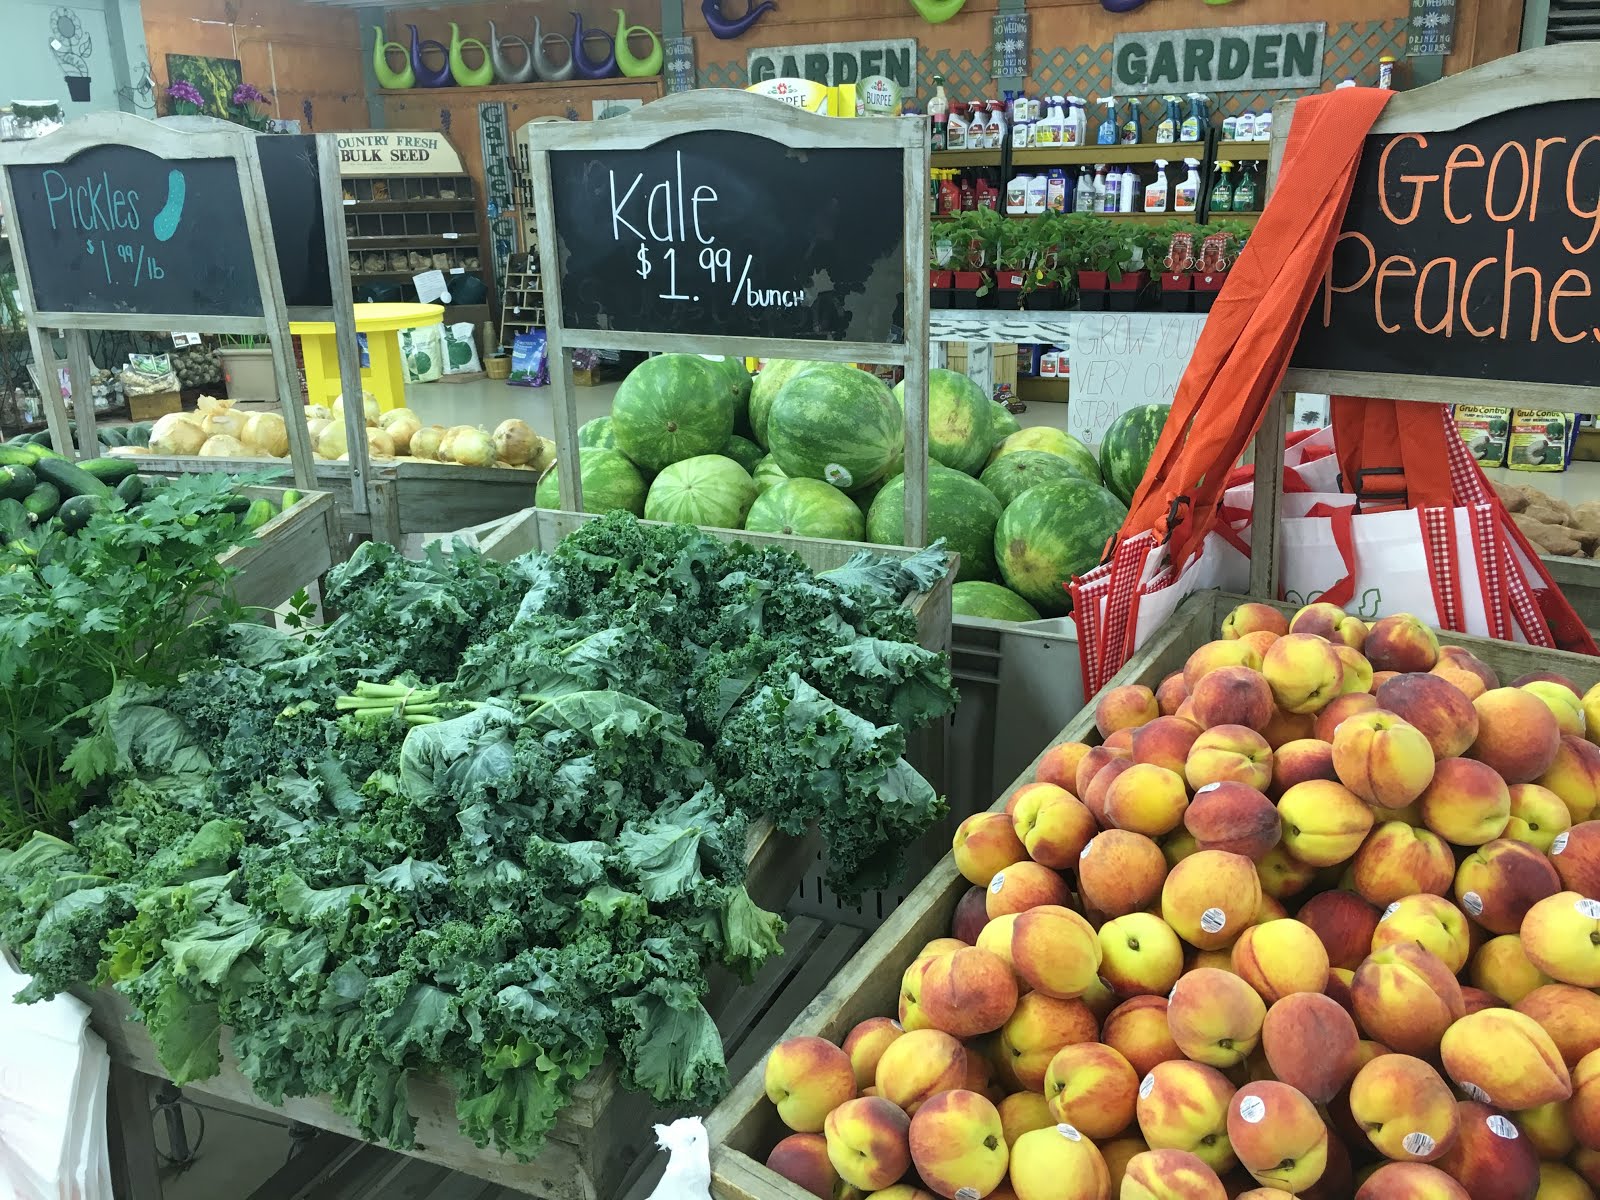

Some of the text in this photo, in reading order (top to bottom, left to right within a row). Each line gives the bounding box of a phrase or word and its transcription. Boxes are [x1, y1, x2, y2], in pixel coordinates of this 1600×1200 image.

[751, 48, 910, 87] GARDEN
[1116, 31, 1317, 85] GARDEN
[866, 91, 892, 107] BURPEE
[337, 136, 438, 150] OUNTRY FRESH
[341, 149, 430, 162] BULK SEED
[43, 169, 140, 231] Pickles
[609, 150, 718, 244] Kale
[1323, 228, 1600, 344] Peache
[1077, 315, 1151, 355] GROW
[1075, 359, 1184, 398] VERY OW
[1459, 404, 1507, 414] Grub Control
[1517, 409, 1560, 418] Grub Contro
